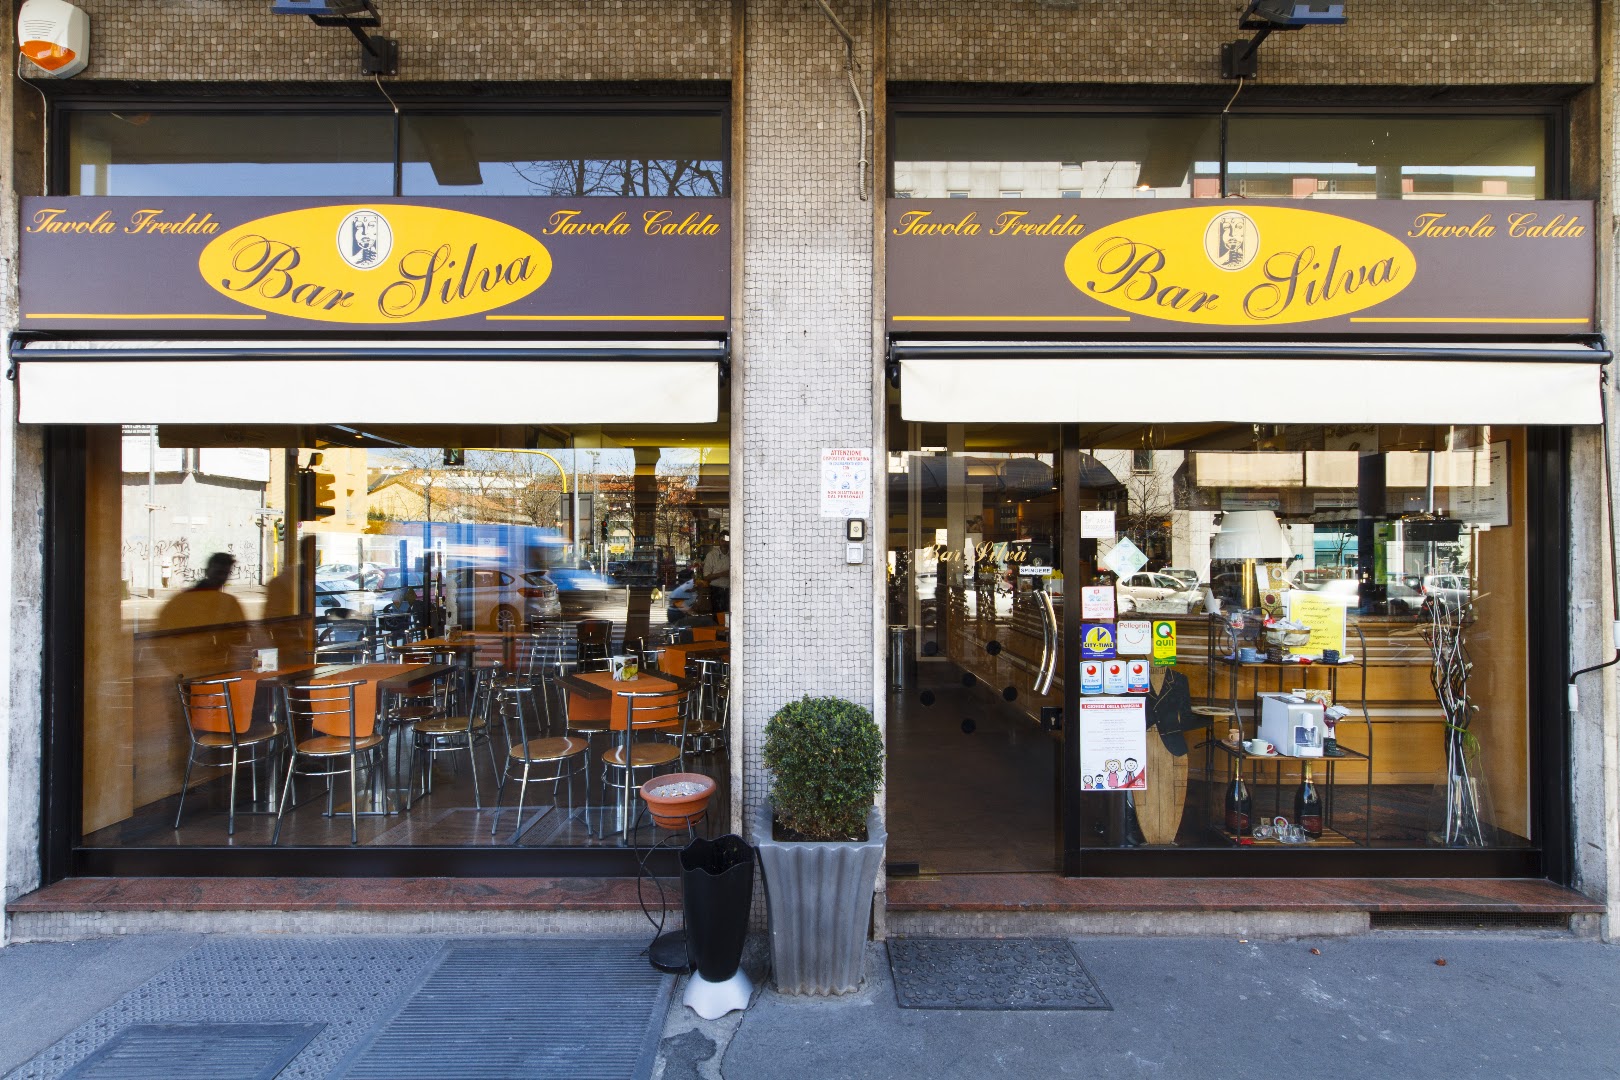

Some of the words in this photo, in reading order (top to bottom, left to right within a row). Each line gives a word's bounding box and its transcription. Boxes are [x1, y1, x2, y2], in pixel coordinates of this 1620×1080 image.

[26, 208, 117, 234] Tavola
[124, 208, 221, 234] Fredda
[542, 209, 631, 235] Tavola
[643, 210, 721, 235] Calda
[893, 210, 982, 236] Tavola
[989, 210, 1086, 236] Fredda
[1407, 212, 1497, 238] Tavola
[1507, 212, 1587, 238] Calda
[221, 234, 354, 311] Bar
[378, 243, 538, 319] Silva
[1086, 236, 1218, 313] Bar
[1242, 245, 1400, 321] Silva
[922, 543, 961, 562] Bar
[974, 541, 1027, 562] Silva
[1119, 622, 1150, 630] Pellegrini
